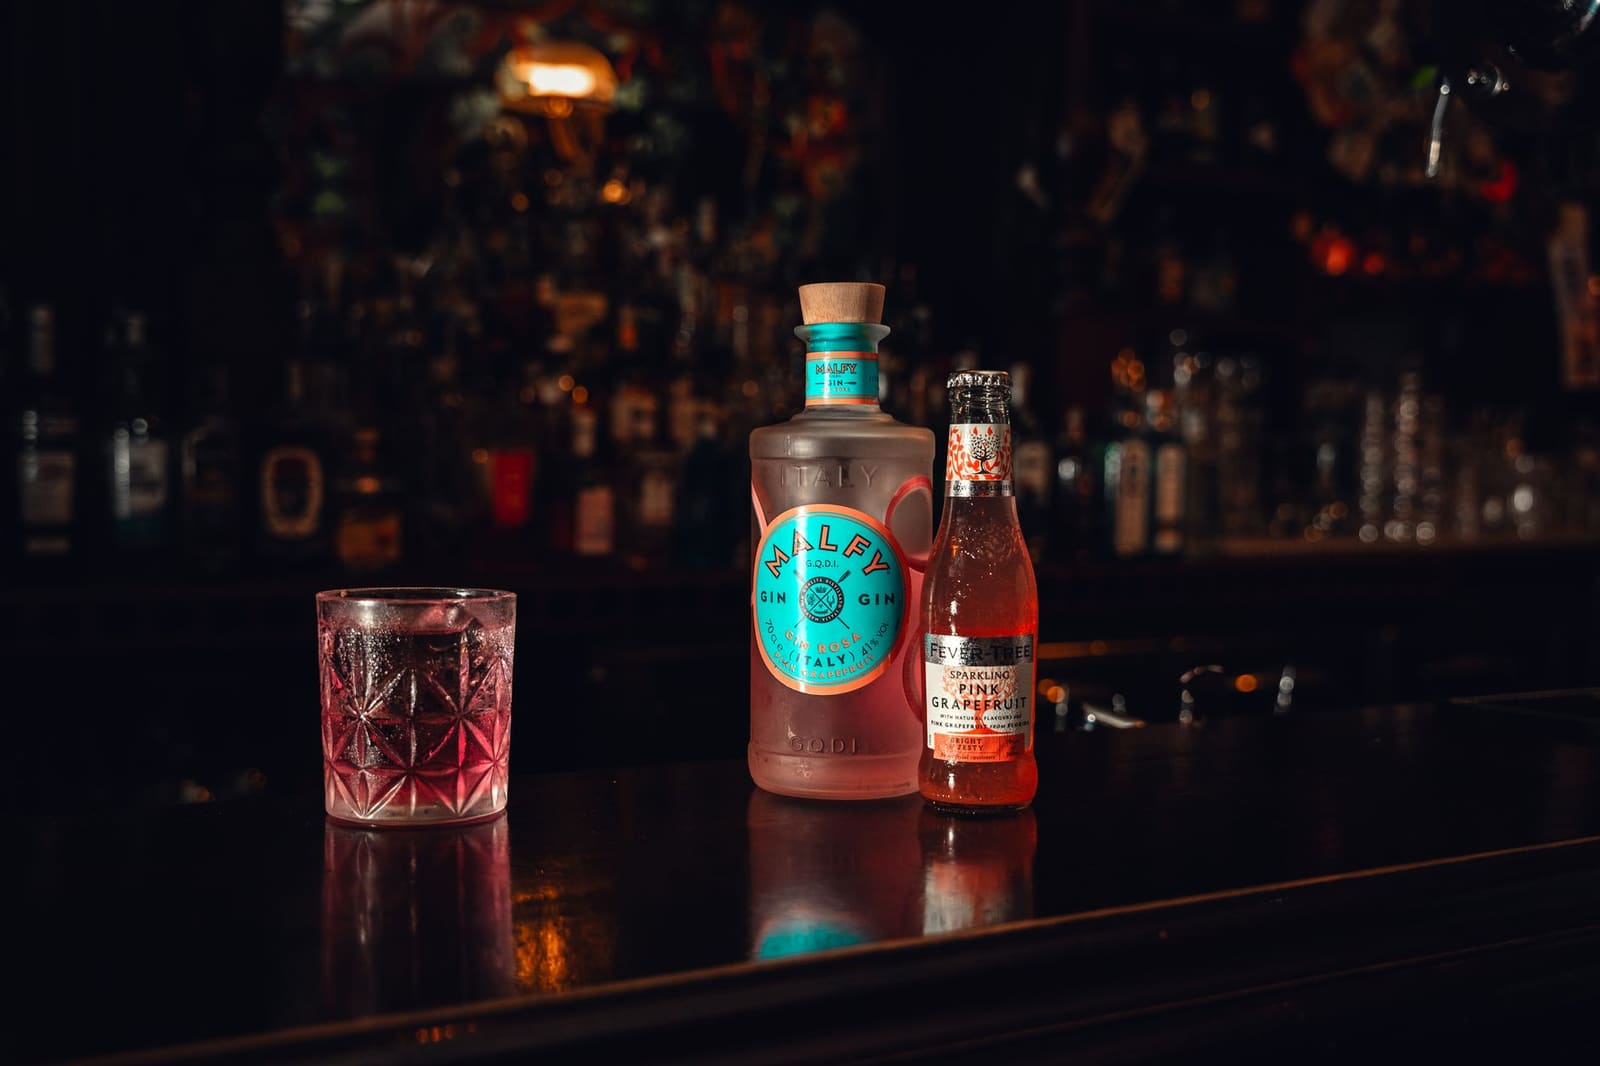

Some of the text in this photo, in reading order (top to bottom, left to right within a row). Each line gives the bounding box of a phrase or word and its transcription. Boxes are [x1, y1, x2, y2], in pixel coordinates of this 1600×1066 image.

[815, 363, 858, 374] MALFY
[780, 464, 879, 488] ITALY
[765, 524, 890, 579] MALFY
[806, 559, 839, 569] G.Q.D.I.
[760, 591, 896, 606] GIN GIN
[785, 630, 862, 654] GIN ROSA
[788, 650, 856, 667] (ITALY)
[930, 642, 1031, 661] FEVER-TREE
[802, 653, 874, 679] GRAPEFRUIT
[950, 670, 1010, 680] SPARKLING
[959, 684, 1000, 695] PINK
[931, 696, 1027, 711] GRAPEFRUIT
[944, 722, 987, 730] GRAPEFRUIT
[790, 736, 858, 754] GQDI
